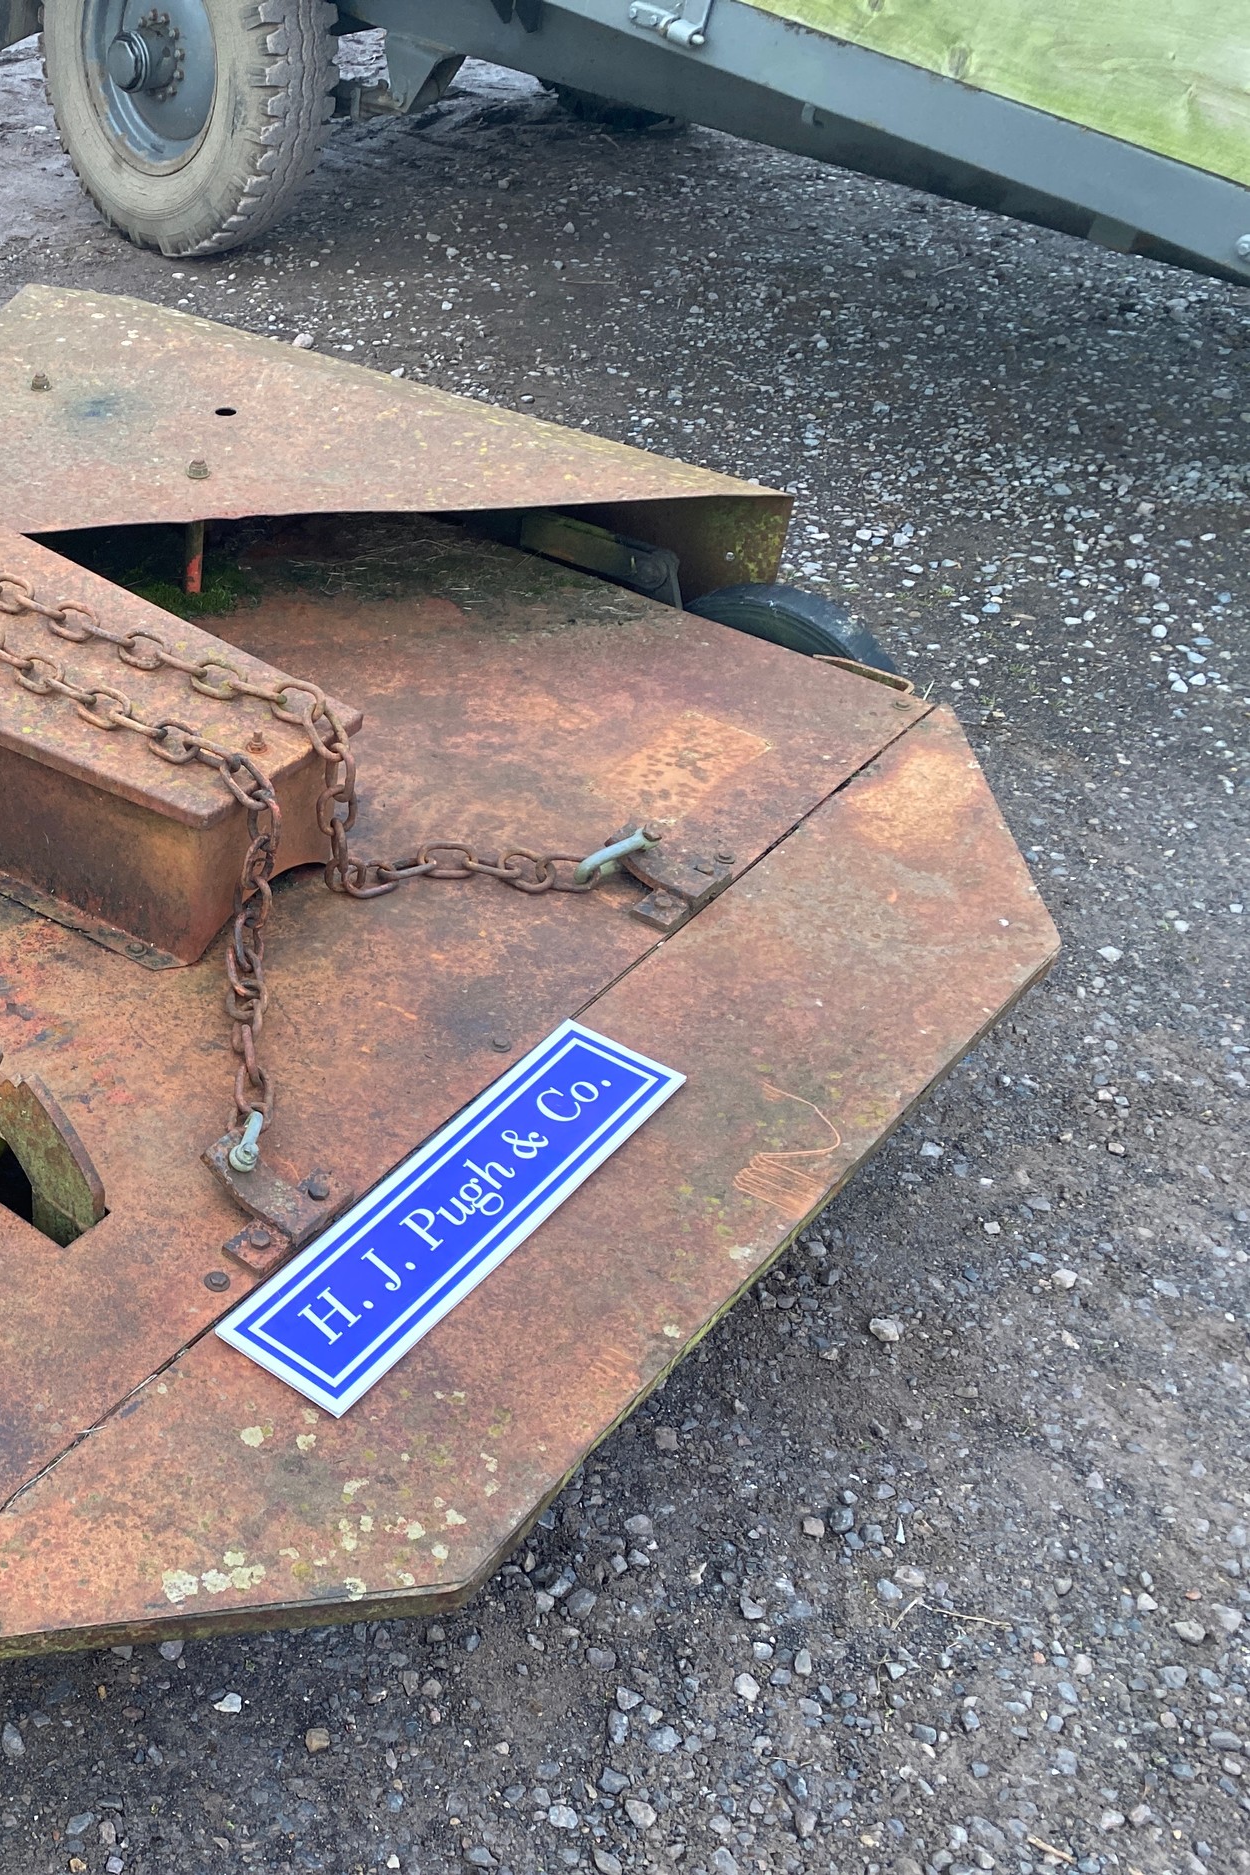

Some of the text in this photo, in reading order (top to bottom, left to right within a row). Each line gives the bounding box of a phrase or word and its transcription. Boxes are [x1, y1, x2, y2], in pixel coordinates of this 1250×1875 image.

[297, 1079, 612, 1346] H. J. Pugh & Co.
